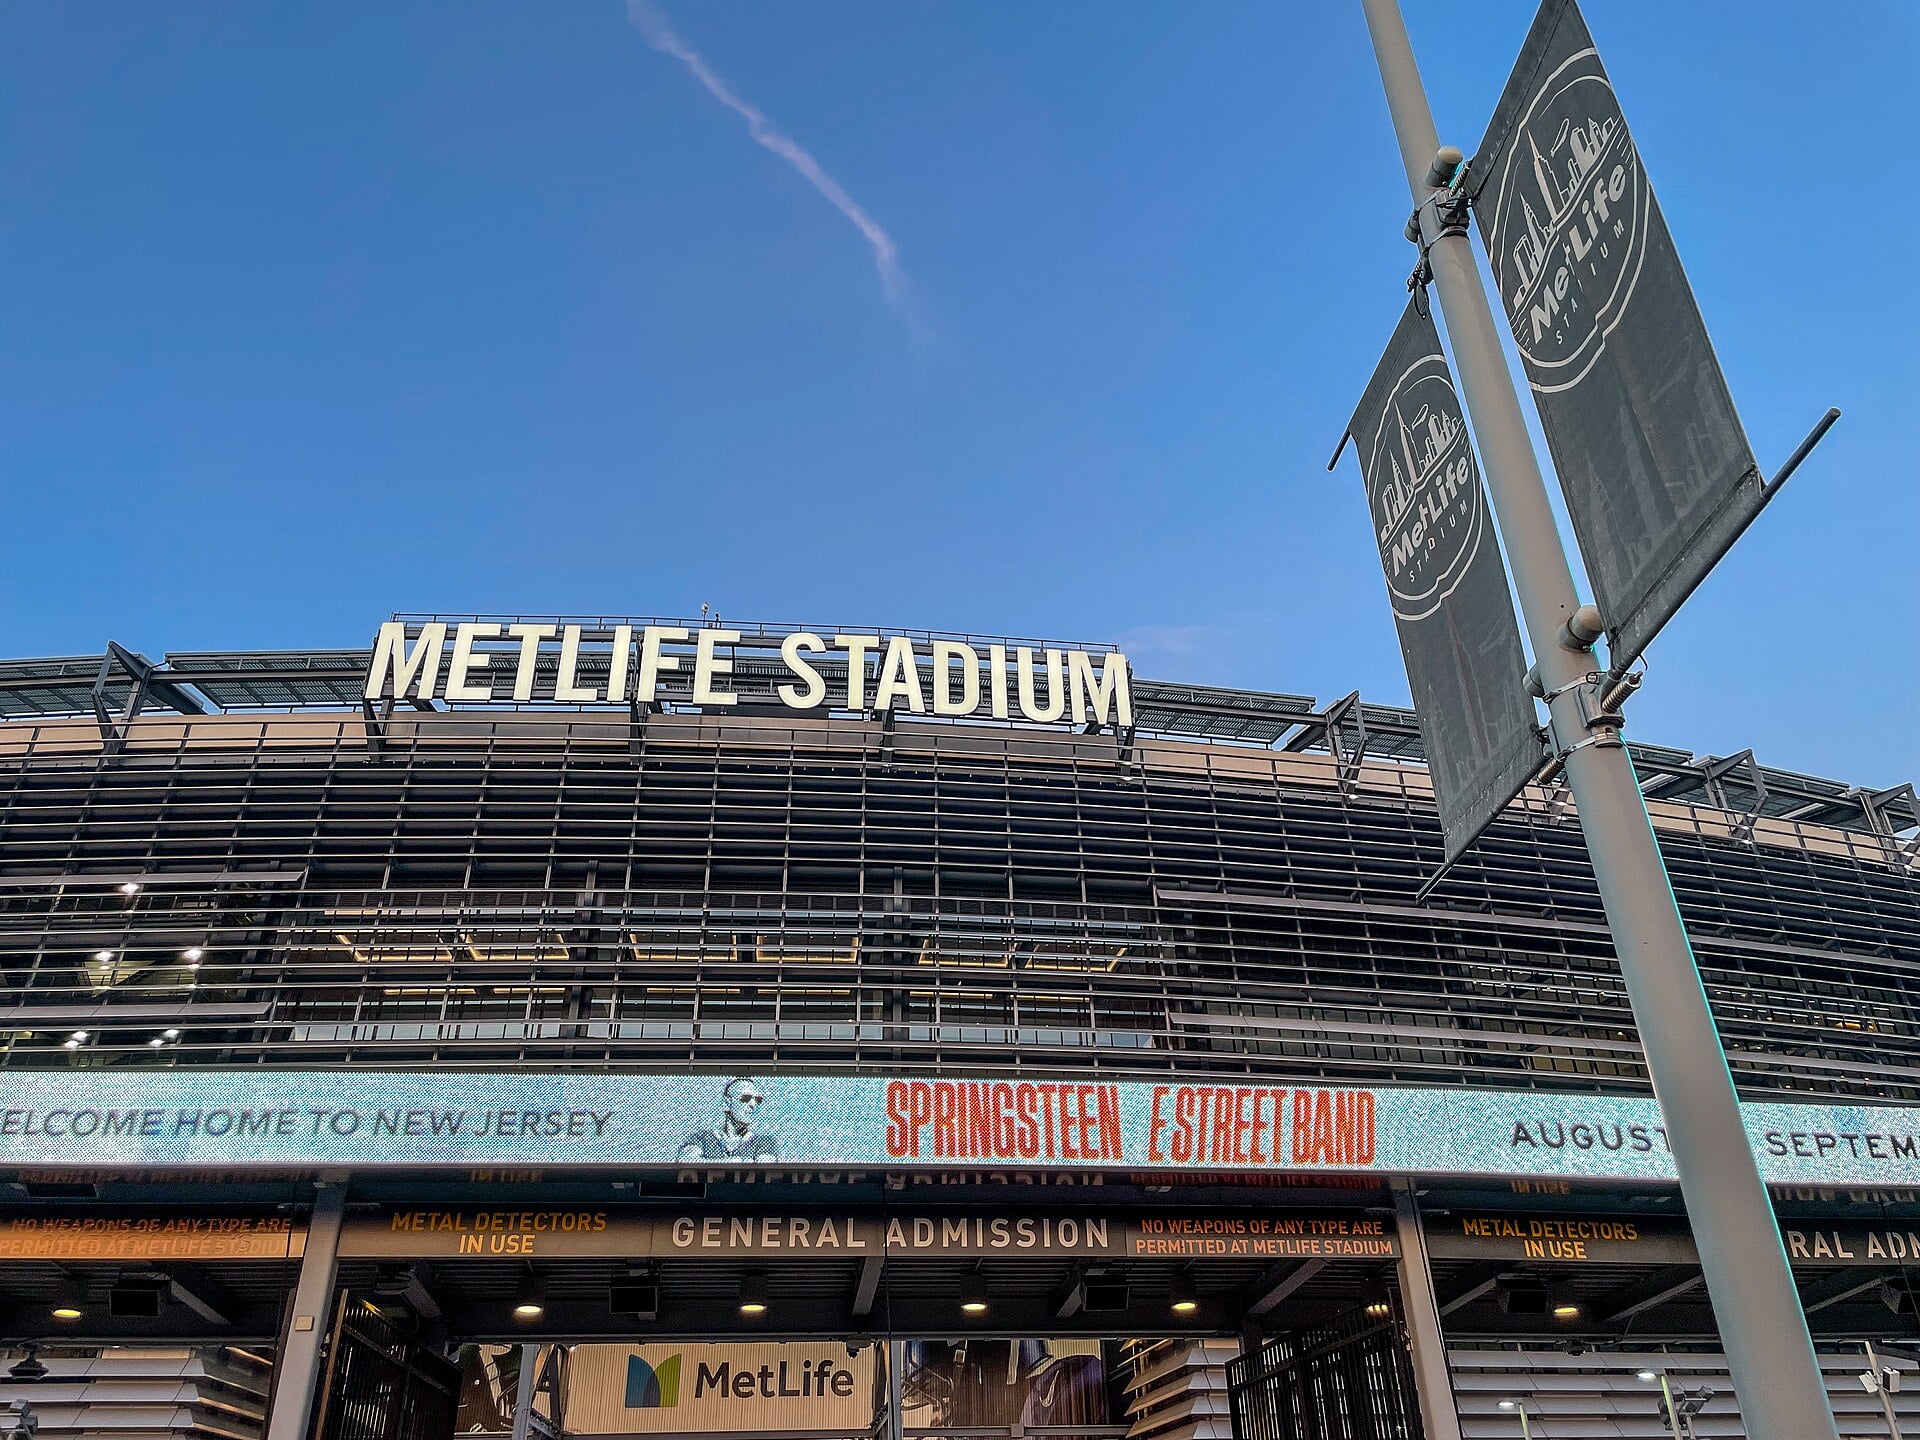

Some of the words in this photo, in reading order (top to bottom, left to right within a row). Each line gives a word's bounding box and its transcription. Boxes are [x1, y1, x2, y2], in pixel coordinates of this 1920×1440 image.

[1530, 165, 1626, 344] MetLife
[1392, 454, 1469, 576] MetLife
[1409, 499, 1468, 583] STADIUM
[364, 622, 742, 706] METLIFE
[777, 632, 1134, 728] STADIUM
[0, 1108, 165, 1136] ELCOME
[174, 1108, 298, 1136] HOME
[308, 1108, 360, 1136] TO
[371, 1108, 468, 1136] NEW
[473, 1108, 615, 1138] JERSEY
[886, 1080, 1123, 1161] SPRINGSTEEN
[1291, 1089, 1376, 1165] BAND
[1764, 1130, 1920, 1160] SEPTEM
[11, 1218, 38, 1233] NO
[41, 1218, 132, 1233] WEAPONS
[252, 1218, 292, 1232] ARE
[391, 1211, 468, 1232] METAL
[474, 1211, 608, 1232] DETECTORS
[672, 1217, 867, 1248] GENERAL
[885, 1217, 1109, 1248] ADMISSION
[1141, 1218, 1164, 1234] NO
[1167, 1218, 1246, 1235] WEAPONS
[1250, 1219, 1269, 1235] OF
[1273, 1219, 1305, 1235] ANY
[1308, 1220, 1348, 1236] TYPE
[1351, 1220, 1384, 1236] ARE
[1463, 1217, 1527, 1238] METAL
[1531, 1219, 1638, 1241] DETECTORS
[458, 1233, 484, 1254] IN
[490, 1233, 536, 1254] USE
[1135, 1238, 1227, 1254] PERMITTED
[1230, 1239, 1250, 1254] AT
[1252, 1239, 1322, 1255] METLIFE
[1324, 1239, 1394, 1256] STADIUM
[1524, 1239, 1545, 1258] IN
[1549, 1240, 1588, 1260] USE
[1786, 1230, 1855, 1259] RAL
[695, 1359, 855, 1399] MetLife
